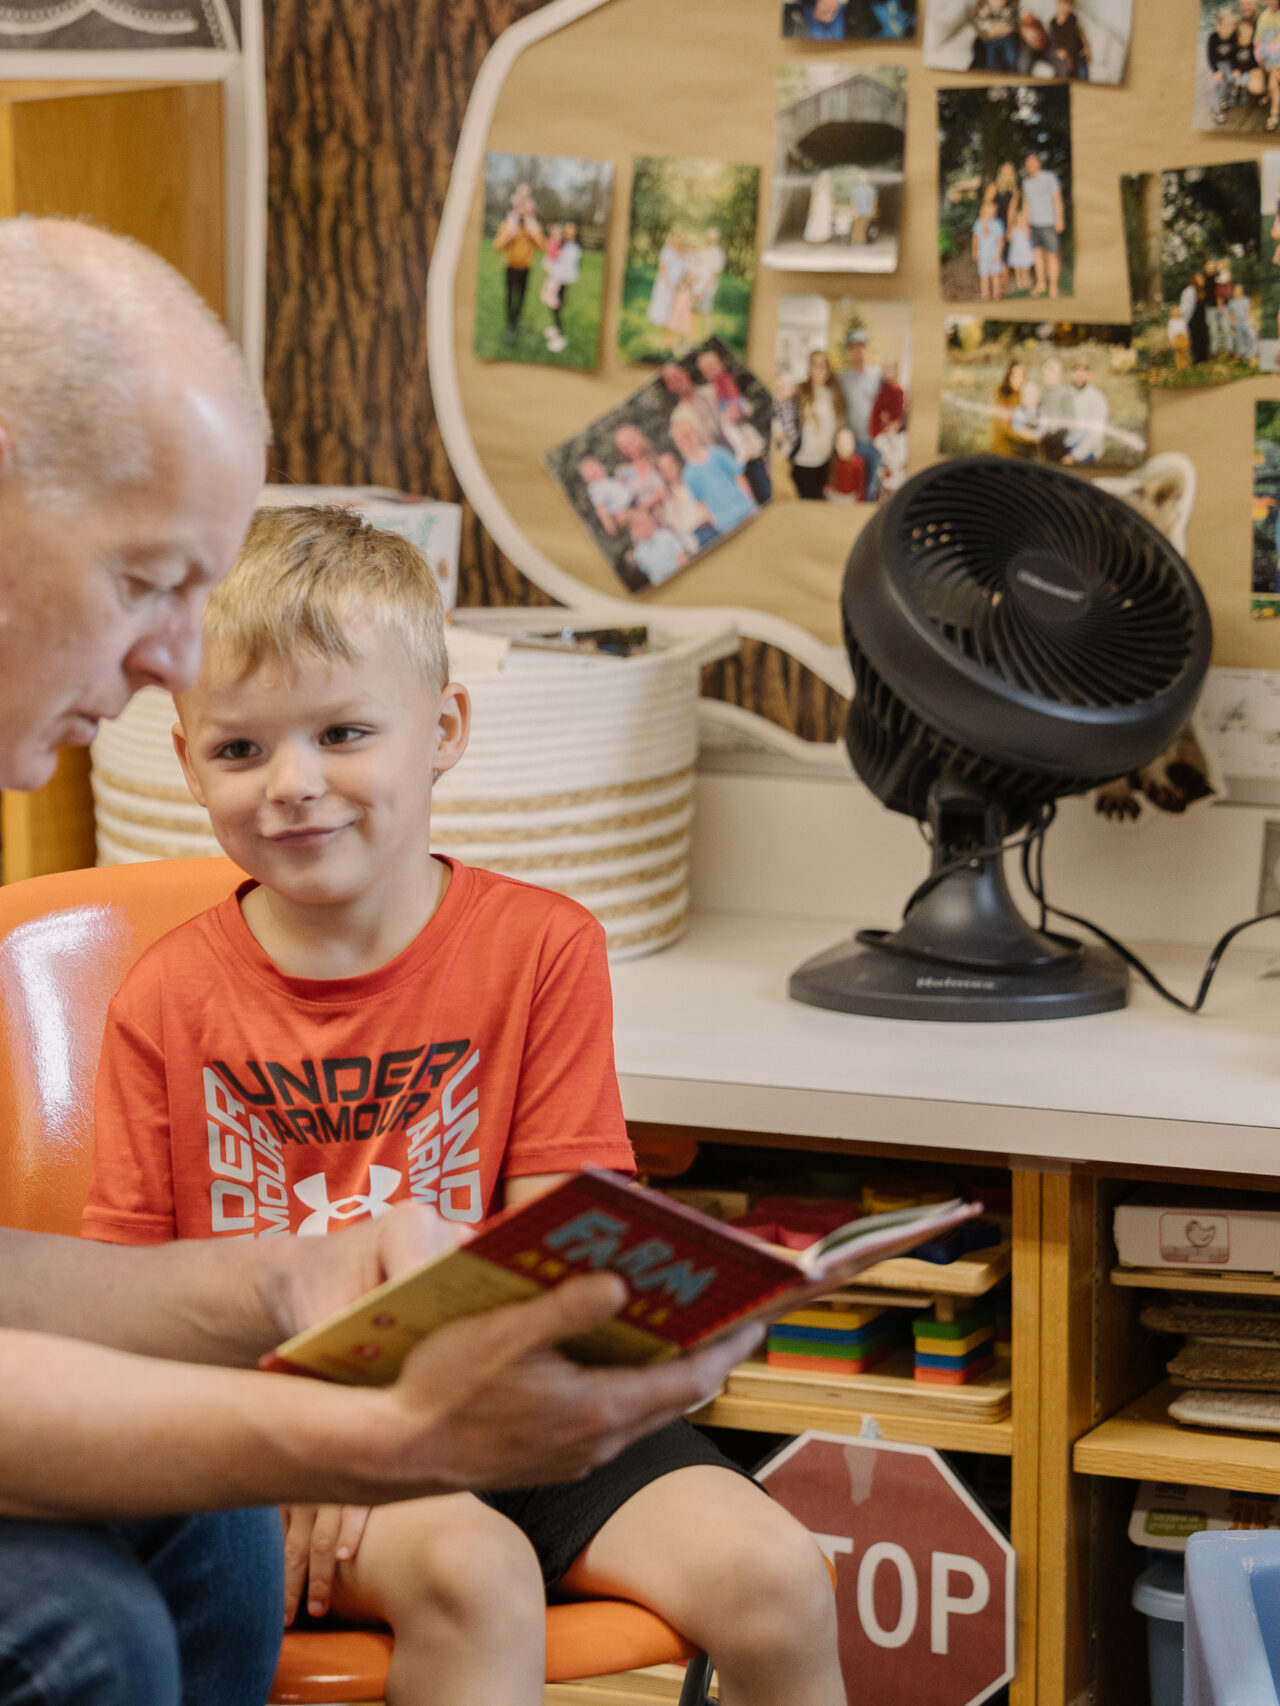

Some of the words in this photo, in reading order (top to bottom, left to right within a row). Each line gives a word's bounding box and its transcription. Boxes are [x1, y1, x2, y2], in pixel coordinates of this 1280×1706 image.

[212, 1038, 471, 1107] UNDER
[265, 1092, 431, 1146] ARMOUR
[544, 1209, 717, 1305] FARM
